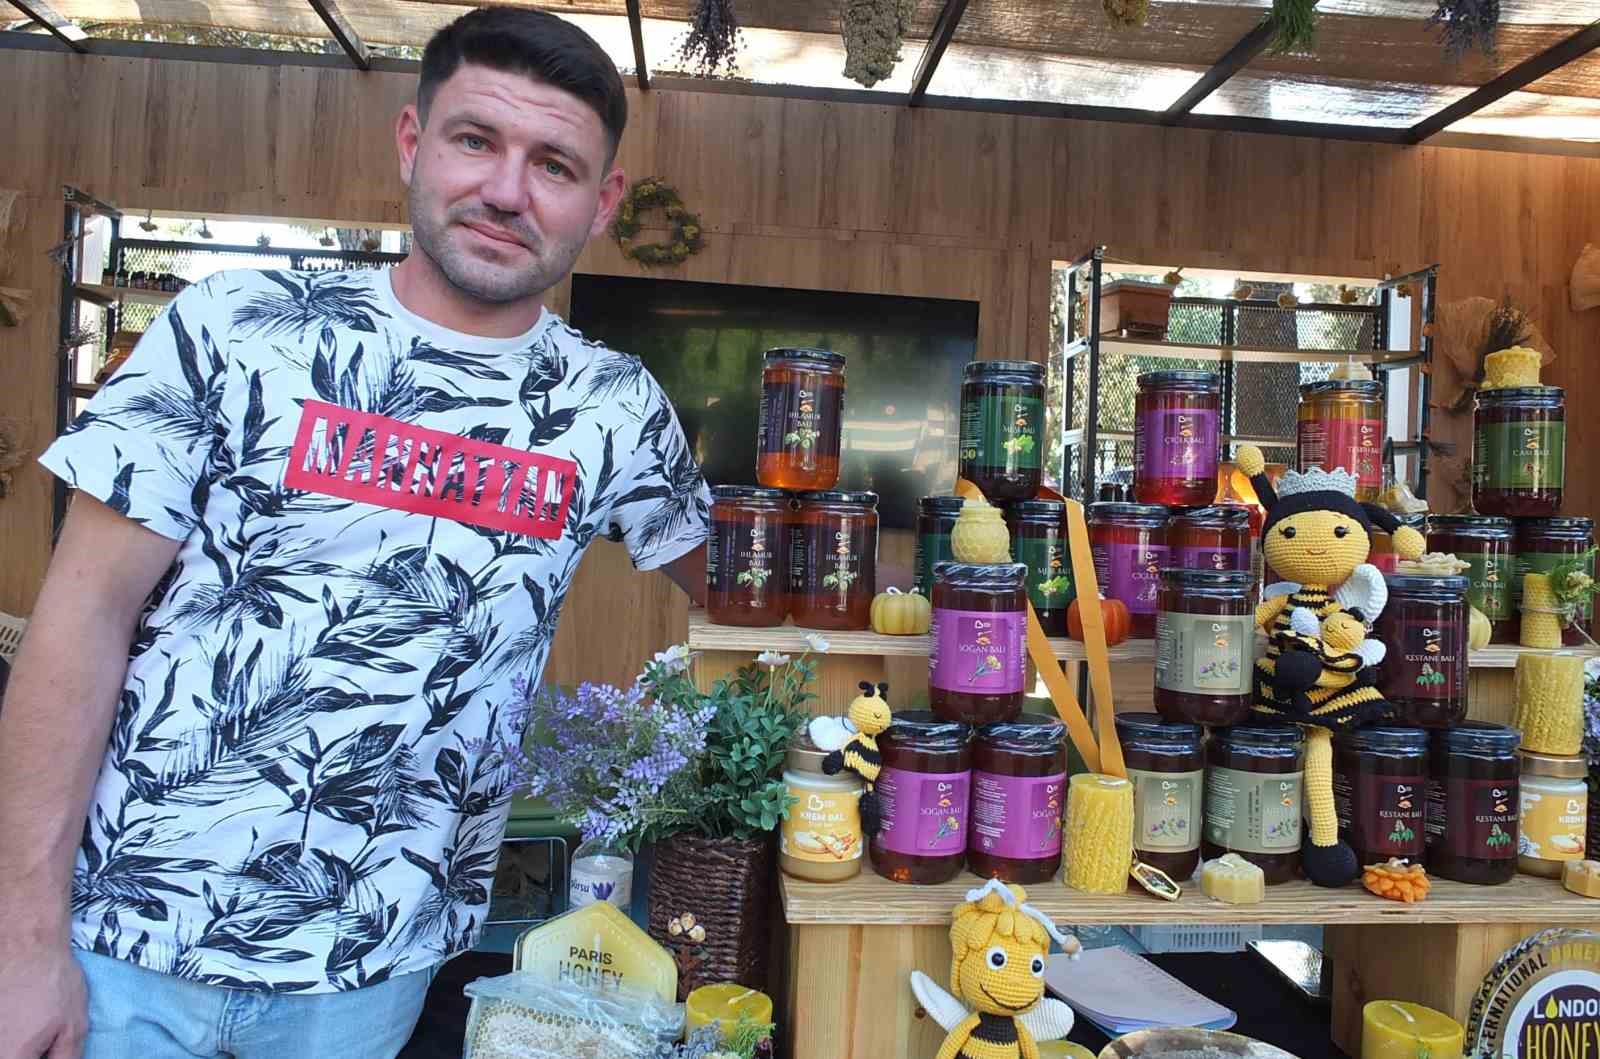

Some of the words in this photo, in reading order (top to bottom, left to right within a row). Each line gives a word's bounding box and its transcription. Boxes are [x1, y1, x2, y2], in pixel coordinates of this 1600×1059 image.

[302, 416, 566, 522] MANHATTAN
[1405, 654, 1438, 662] KESTANE
[1379, 809, 1410, 818] KESTANE
[1475, 815, 1507, 823] KESTANE
[569, 946, 613, 966] PARIS
[559, 960, 624, 989] HONEY
[1481, 953, 1548, 1059] NTERNATIONAL
[1533, 994, 1600, 1019] LONDO
